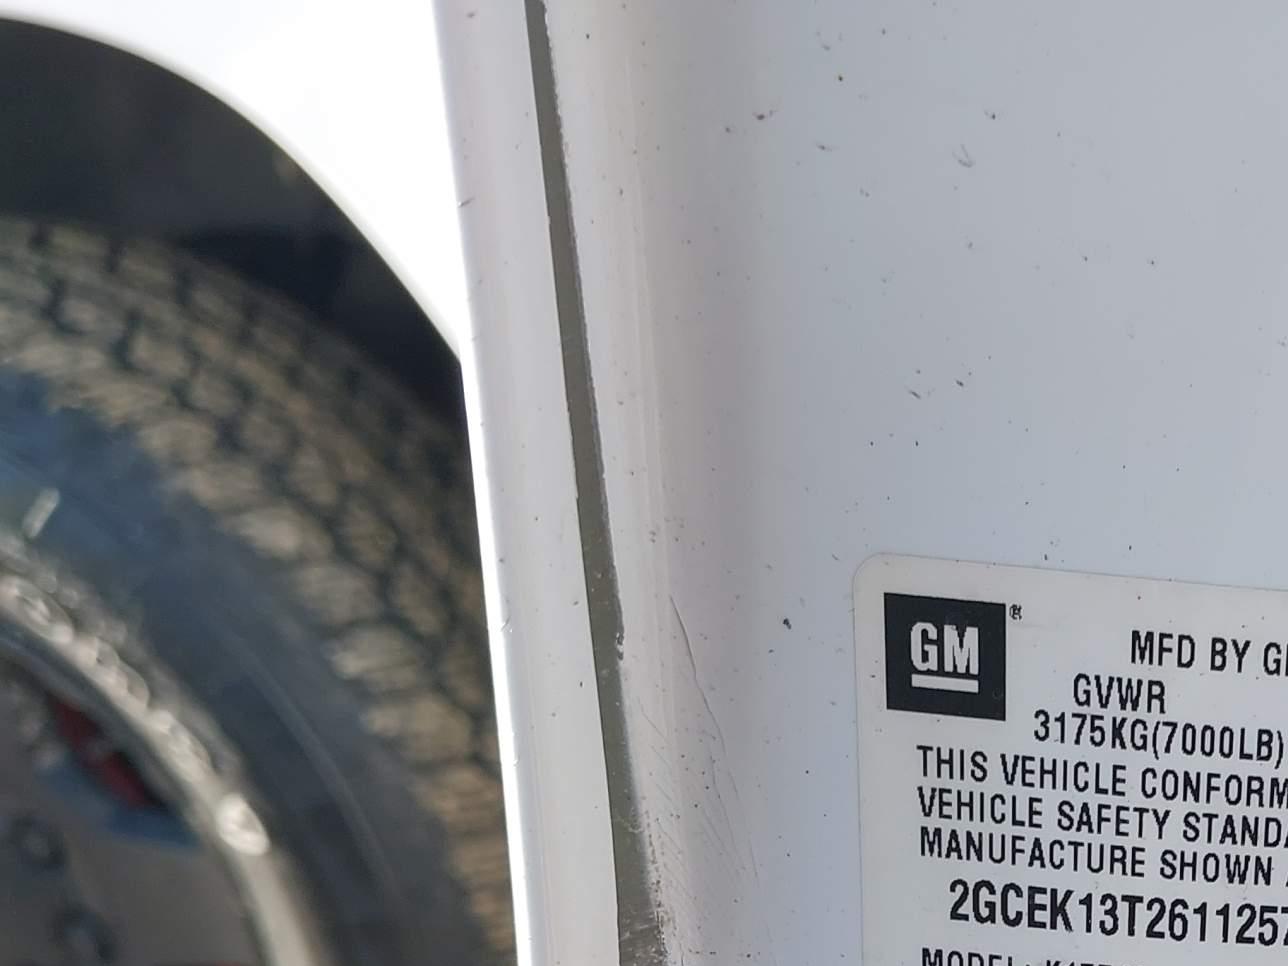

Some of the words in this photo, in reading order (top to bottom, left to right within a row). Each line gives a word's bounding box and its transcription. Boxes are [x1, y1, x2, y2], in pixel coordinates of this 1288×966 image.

[910, 622, 979, 675] GM
[1131, 630, 1195, 669] MFD
[1210, 637, 1251, 673] BY
[1073, 673, 1166, 714] GVWR
[1034, 710, 1284, 769] 3175KG(7000LB)
[916, 745, 988, 782] THIS
[1000, 753, 1126, 797] VEHICLE
[917, 786, 1043, 828] VEHICLE
[1057, 800, 1171, 840] SAFETY
[921, 826, 1145, 878] MANUFACTURE
[1160, 849, 1274, 886] SHOWN
